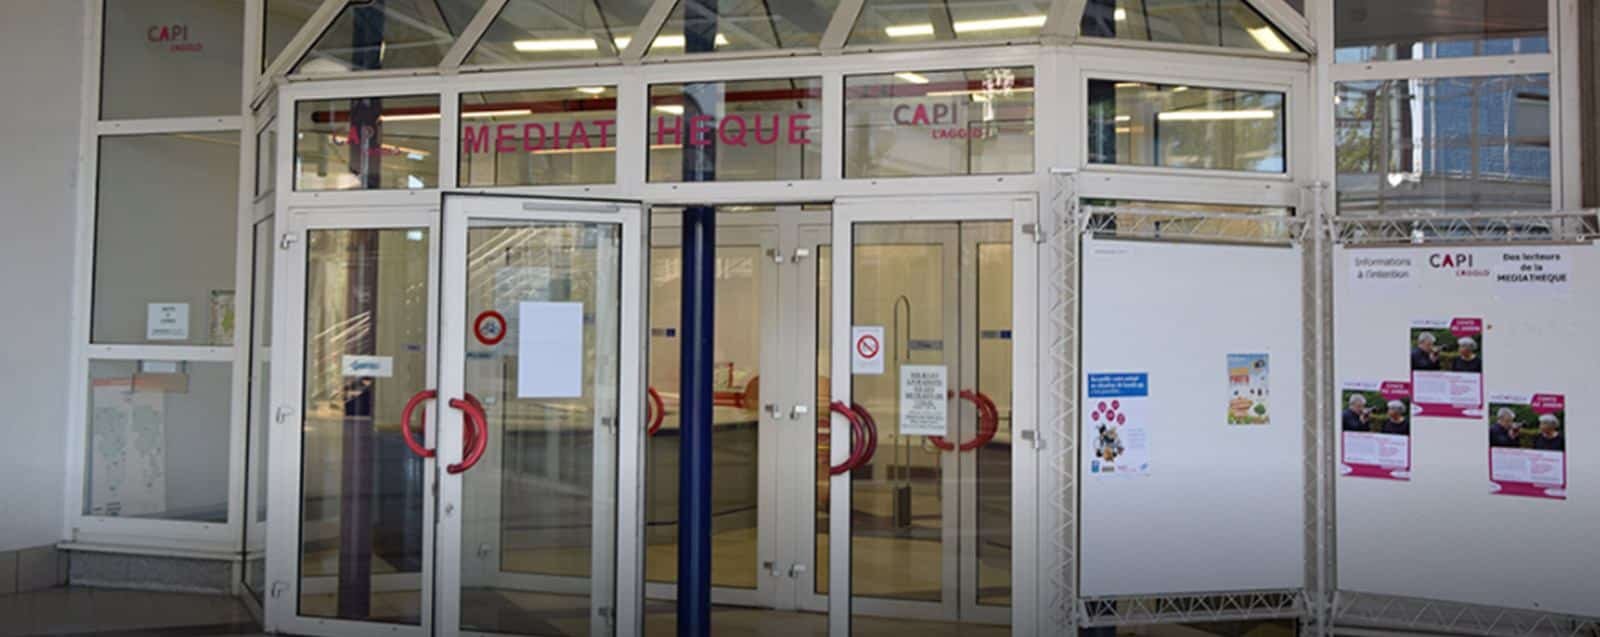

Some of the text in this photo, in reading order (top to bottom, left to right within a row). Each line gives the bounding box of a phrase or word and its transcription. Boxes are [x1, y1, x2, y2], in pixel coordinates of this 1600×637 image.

[147, 24, 189, 42] CAPI
[893, 102, 958, 126] CAPI
[1354, 256, 1412, 267] Informations
[1428, 253, 1474, 269] CAPI
[1503, 252, 1561, 261] Des lecteurs
[1520, 263, 1543, 271] de la
